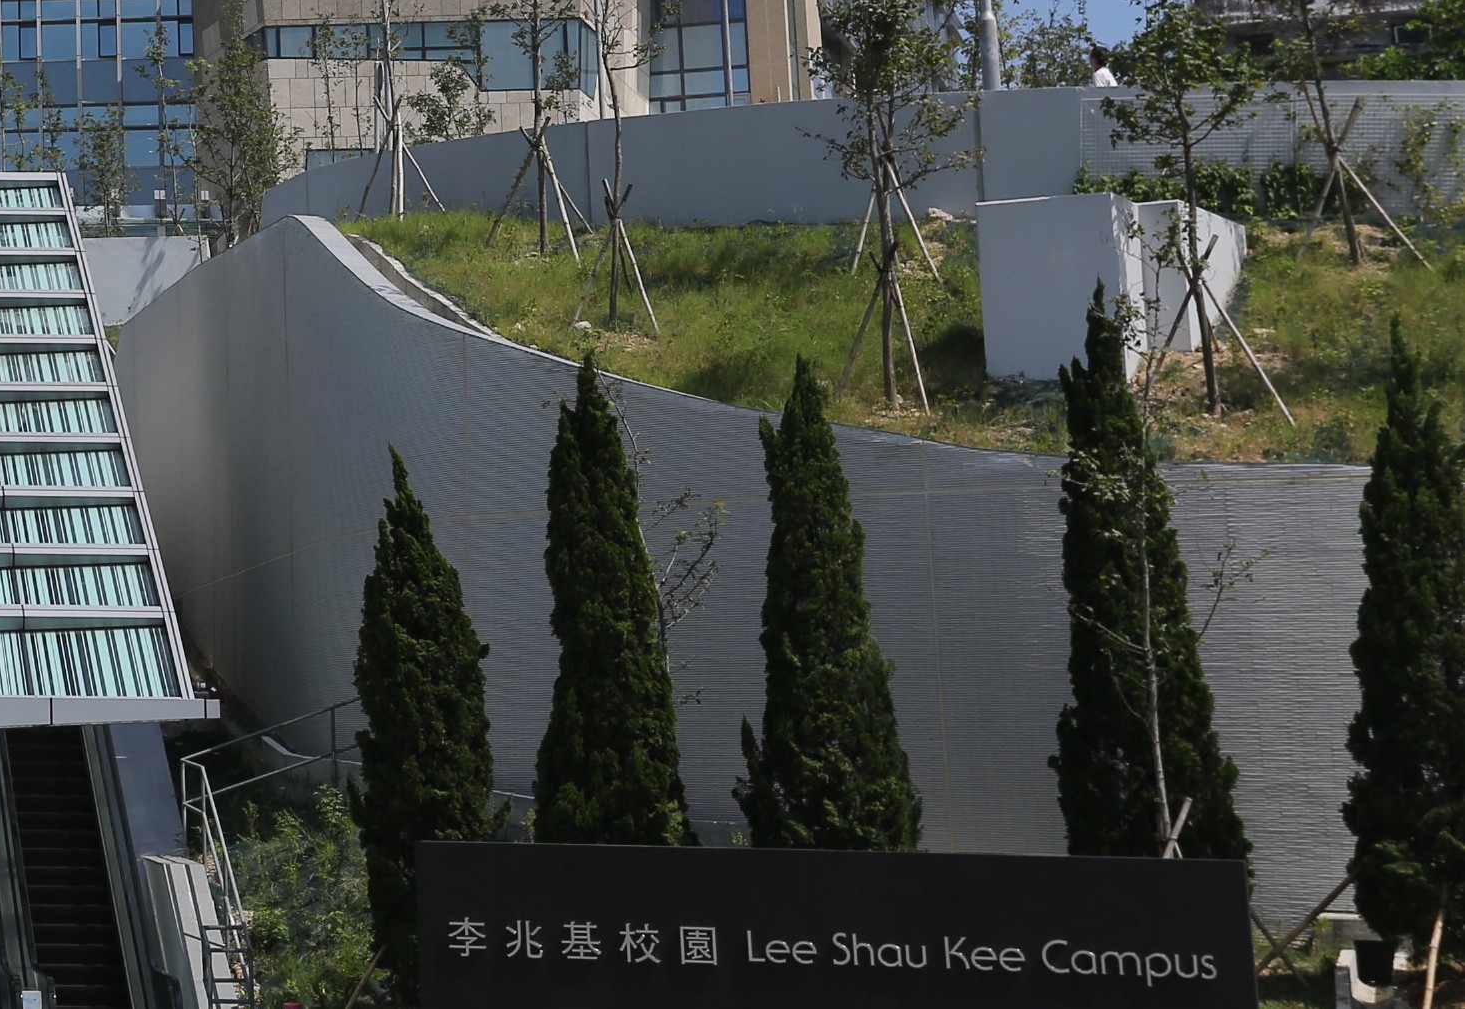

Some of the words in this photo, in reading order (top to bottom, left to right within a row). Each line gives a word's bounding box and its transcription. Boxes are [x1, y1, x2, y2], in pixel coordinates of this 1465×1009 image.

[448, 917, 718, 966] 李兆基校園
[746, 929, 818, 965] Lee
[833, 932, 928, 971] Shau
[944, 936, 1026, 972] Kee
[1042, 940, 1219, 987] Campus
